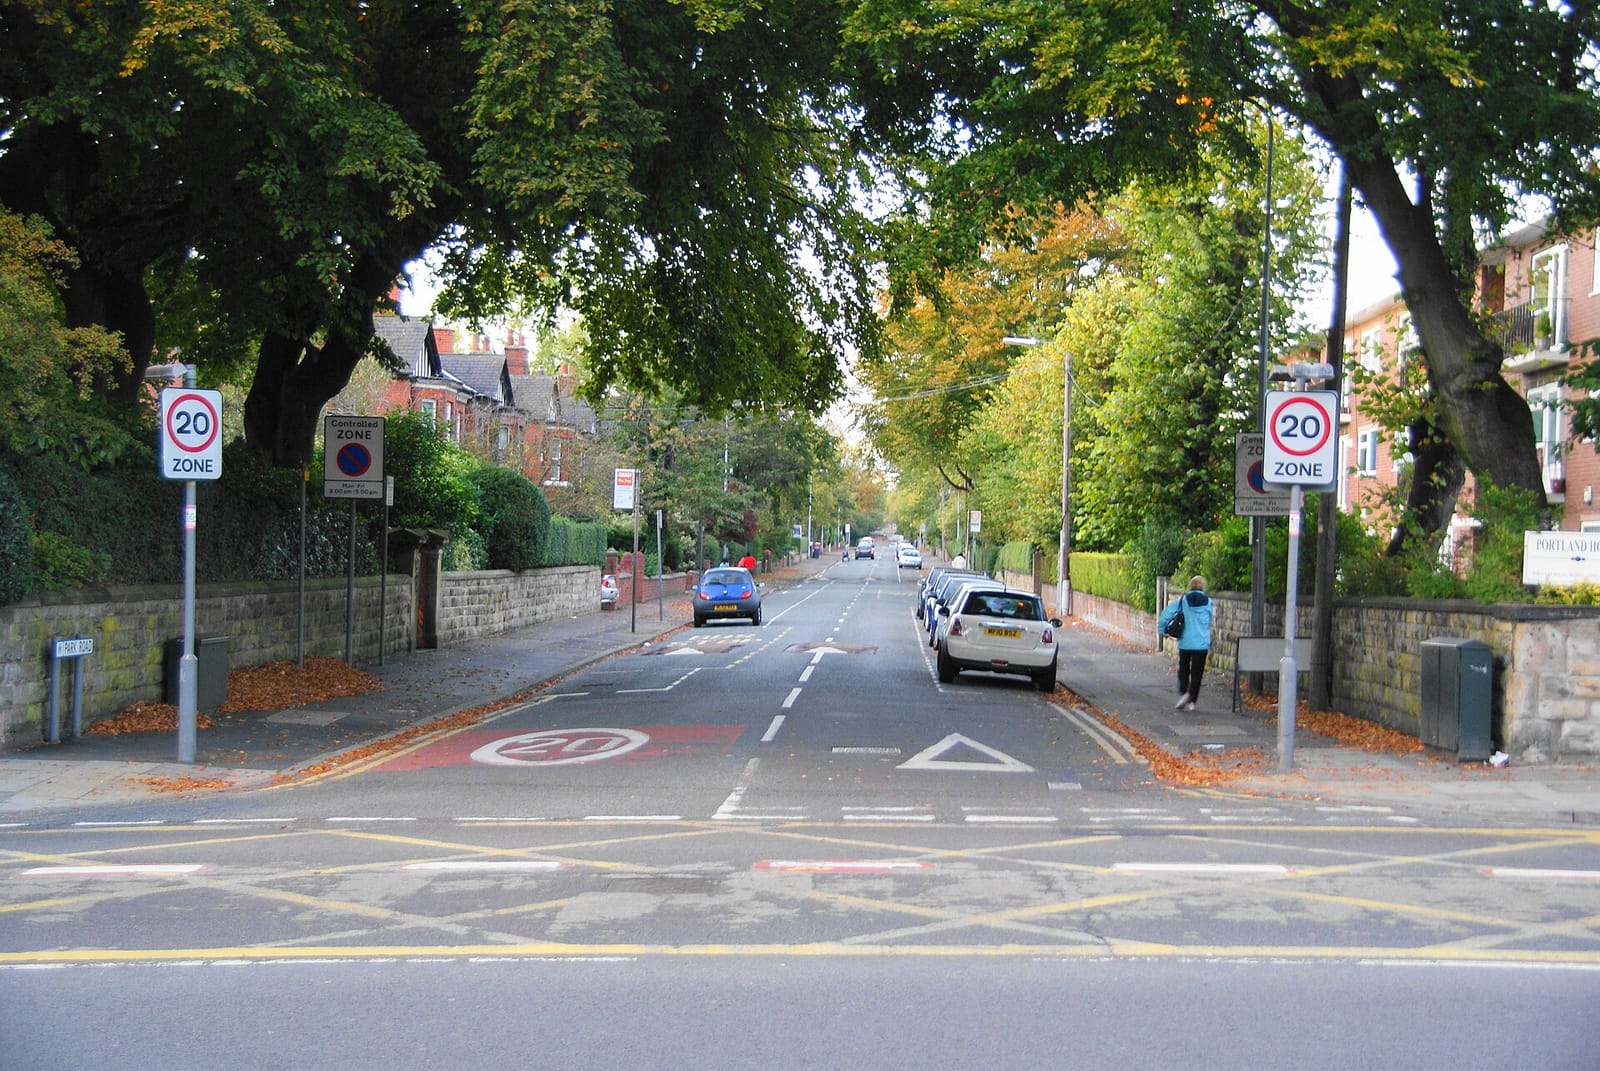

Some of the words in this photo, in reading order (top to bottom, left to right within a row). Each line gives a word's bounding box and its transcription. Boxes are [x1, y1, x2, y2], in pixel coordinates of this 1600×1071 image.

[176, 411, 210, 435] 20
[331, 420, 378, 428] Controlled
[1280, 415, 1320, 438] 20
[337, 430, 372, 440] ZONE
[172, 459, 213, 472] ZONE
[1274, 462, 1323, 476] ZONE
[1536, 538, 1587, 552] PORTLAND
[64, 640, 77, 655] PARK
[79, 639, 92, 653] ROAD
[499, 737, 628, 752] 20
